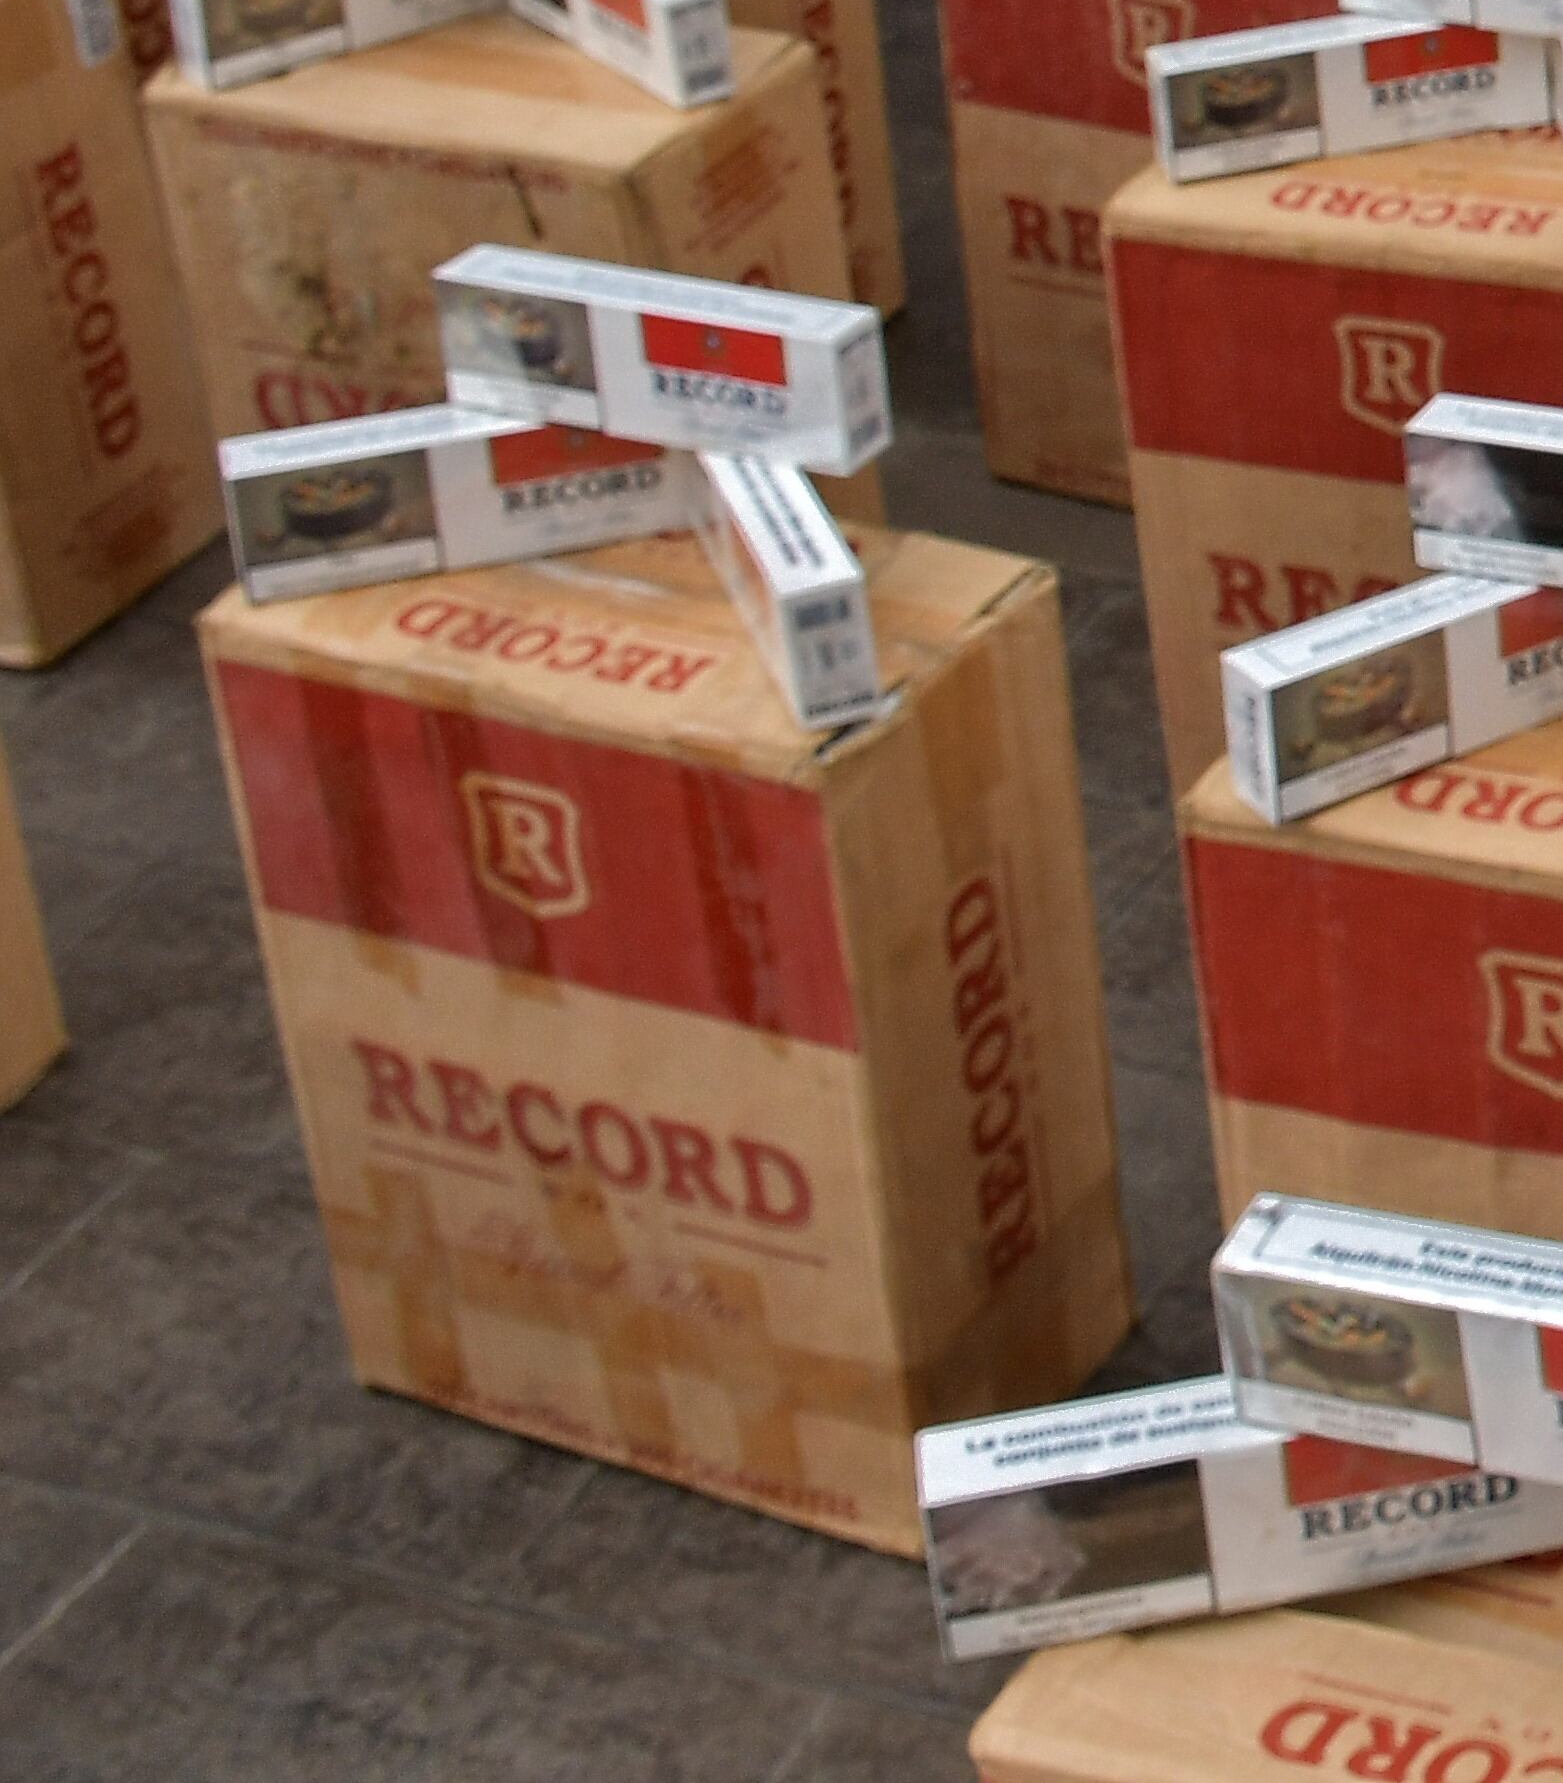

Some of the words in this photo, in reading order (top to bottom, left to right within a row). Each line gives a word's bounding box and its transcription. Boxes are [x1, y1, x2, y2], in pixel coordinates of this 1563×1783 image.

[1371, 68, 1495, 108] RECORD
[1271, 179, 1553, 238] RECORD
[35, 143, 145, 461] RECORD
[652, 370, 787, 416] RECORD
[500, 465, 664, 514] RECORD
[398, 596, 720, 695] RECORD
[942, 874, 1037, 1286] RECORD
[350, 1037, 816, 1232] RECORD
[1301, 1473, 1520, 1540] RECORD
